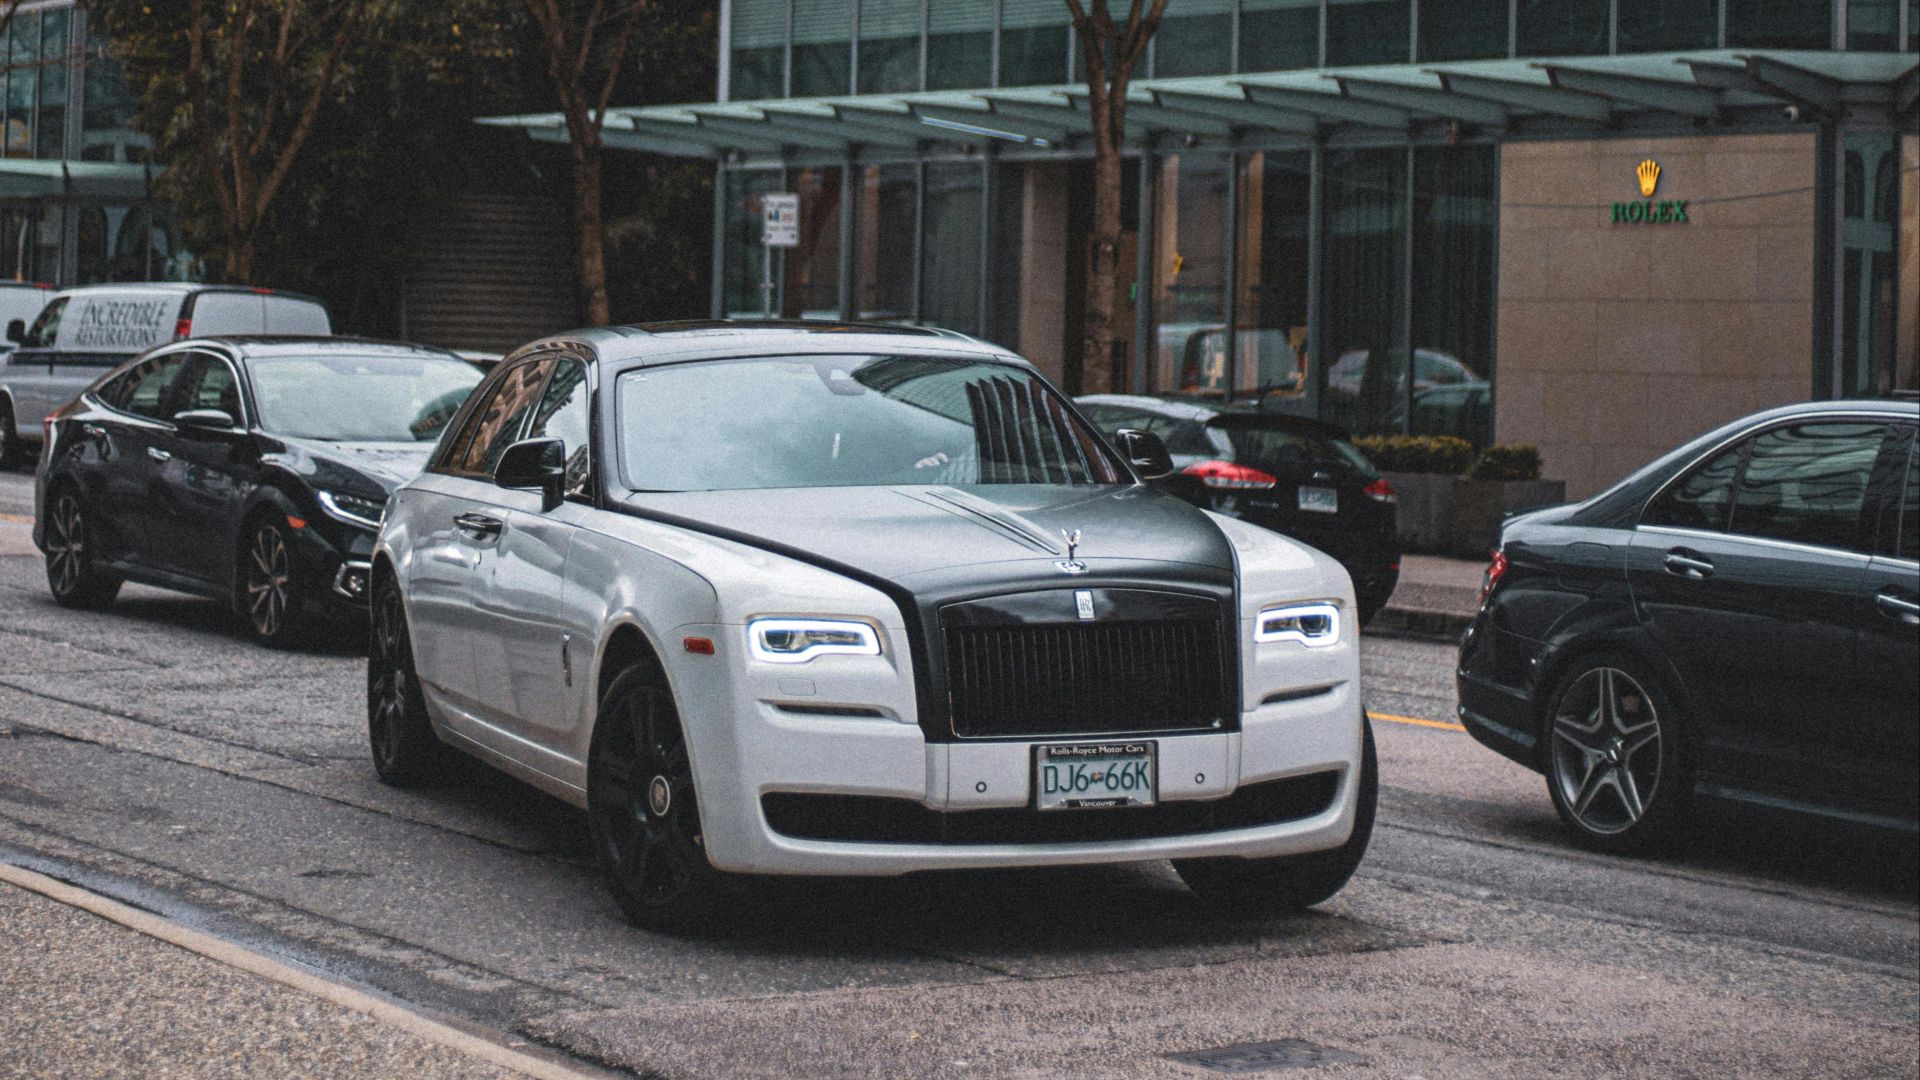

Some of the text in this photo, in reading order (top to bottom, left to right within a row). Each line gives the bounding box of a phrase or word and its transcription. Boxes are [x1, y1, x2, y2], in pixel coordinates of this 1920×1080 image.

[1610, 200, 1688, 224] ROLEX
[81, 300, 167, 326] INCREDIBLE
[75, 325, 157, 347] RESTORATIONS
[1051, 744, 1144, 756] Rolls-Royce Motor Cars
[1079, 799, 1117, 807] Vancouver
